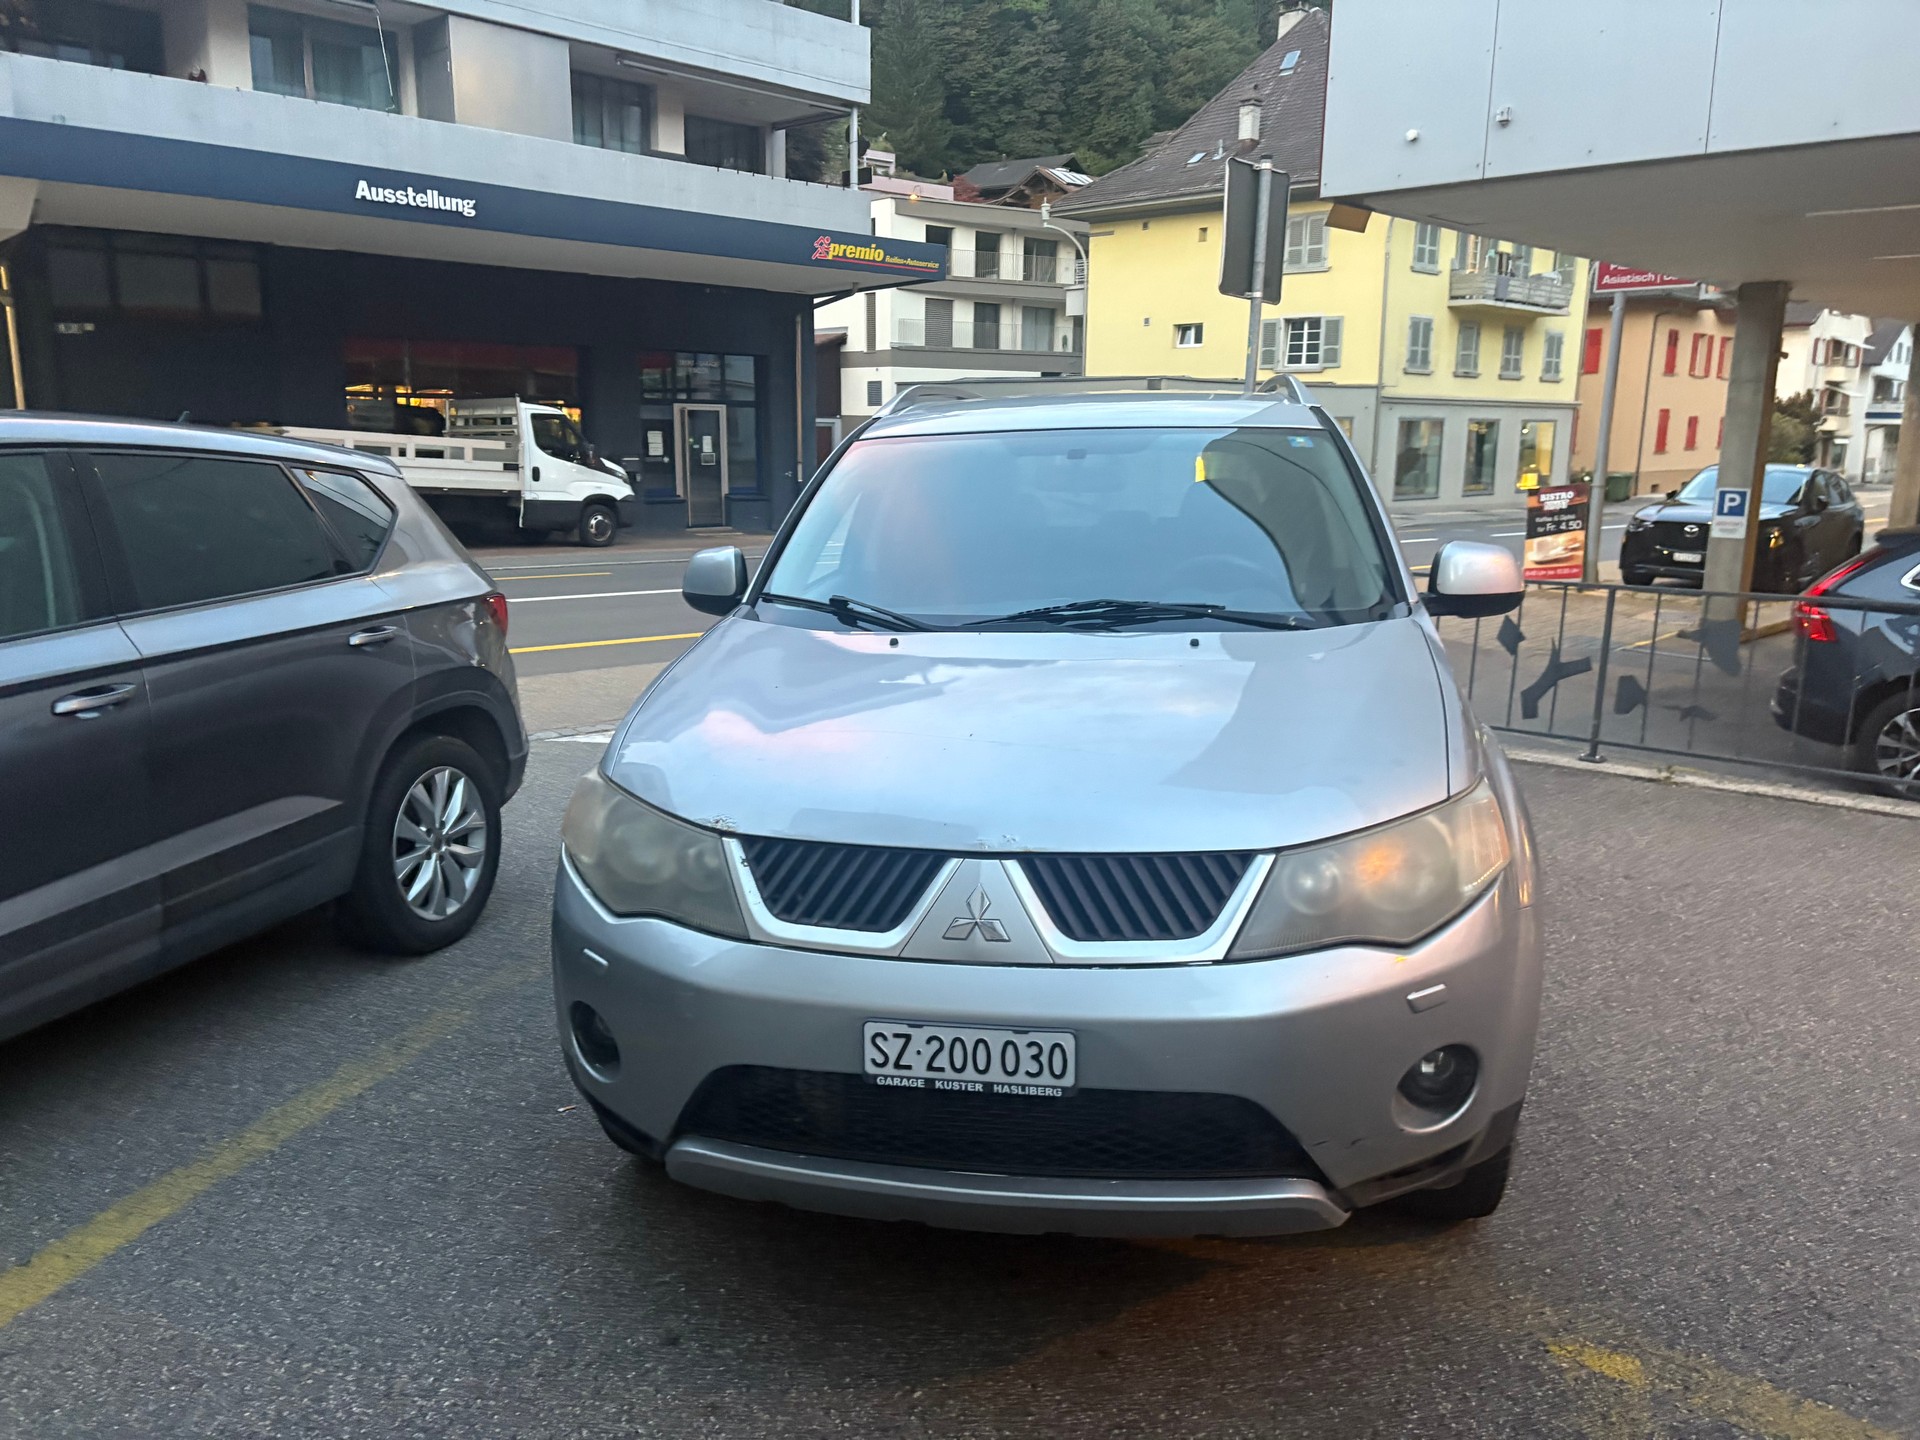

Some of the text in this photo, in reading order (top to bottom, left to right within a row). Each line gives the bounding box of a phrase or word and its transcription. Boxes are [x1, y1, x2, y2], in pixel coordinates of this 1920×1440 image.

[355, 179, 476, 217] Ausstellung
[828, 242, 885, 263] premio
[1602, 272, 1655, 285] Asiatisch
[1540, 491, 1574, 502] BISTRO
[1723, 493, 1741, 514] P
[1559, 520, 1582, 530] 4.50
[876, 1076, 1062, 1098] GARAGE KUSTER HASLIBERG
